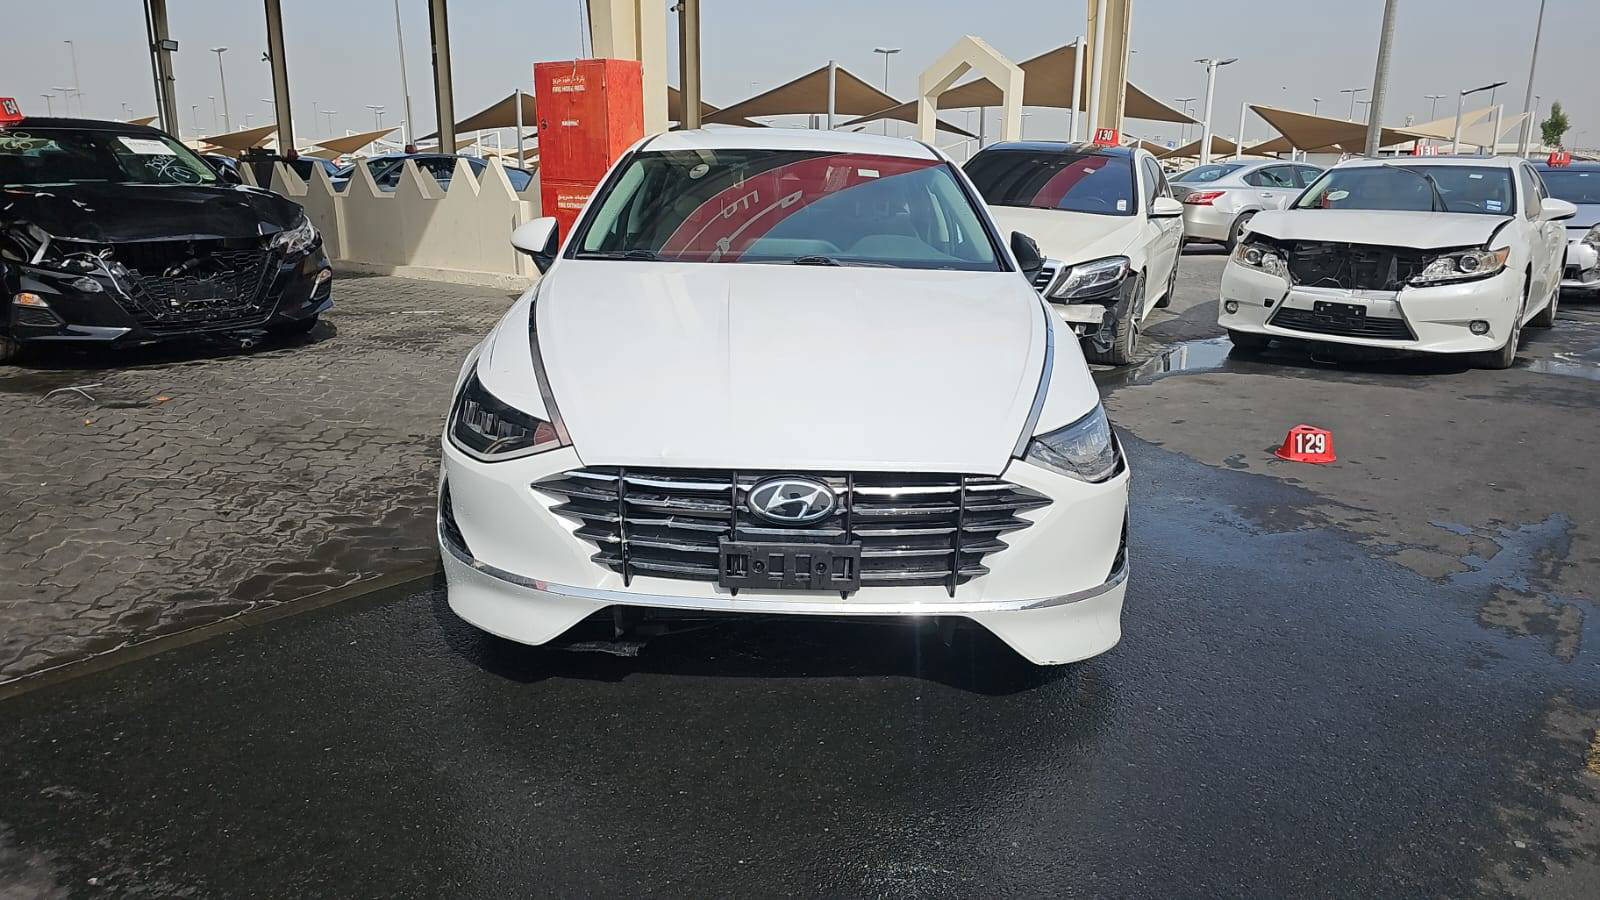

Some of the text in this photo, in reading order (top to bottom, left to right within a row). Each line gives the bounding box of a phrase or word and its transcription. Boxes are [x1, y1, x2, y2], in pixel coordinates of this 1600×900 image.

[3, 99, 19, 115] 134
[1098, 130, 1113, 141] 130
[1420, 145, 1435, 156] 131
[1556, 152, 1565, 161] 71
[1296, 433, 1326, 454] 129
